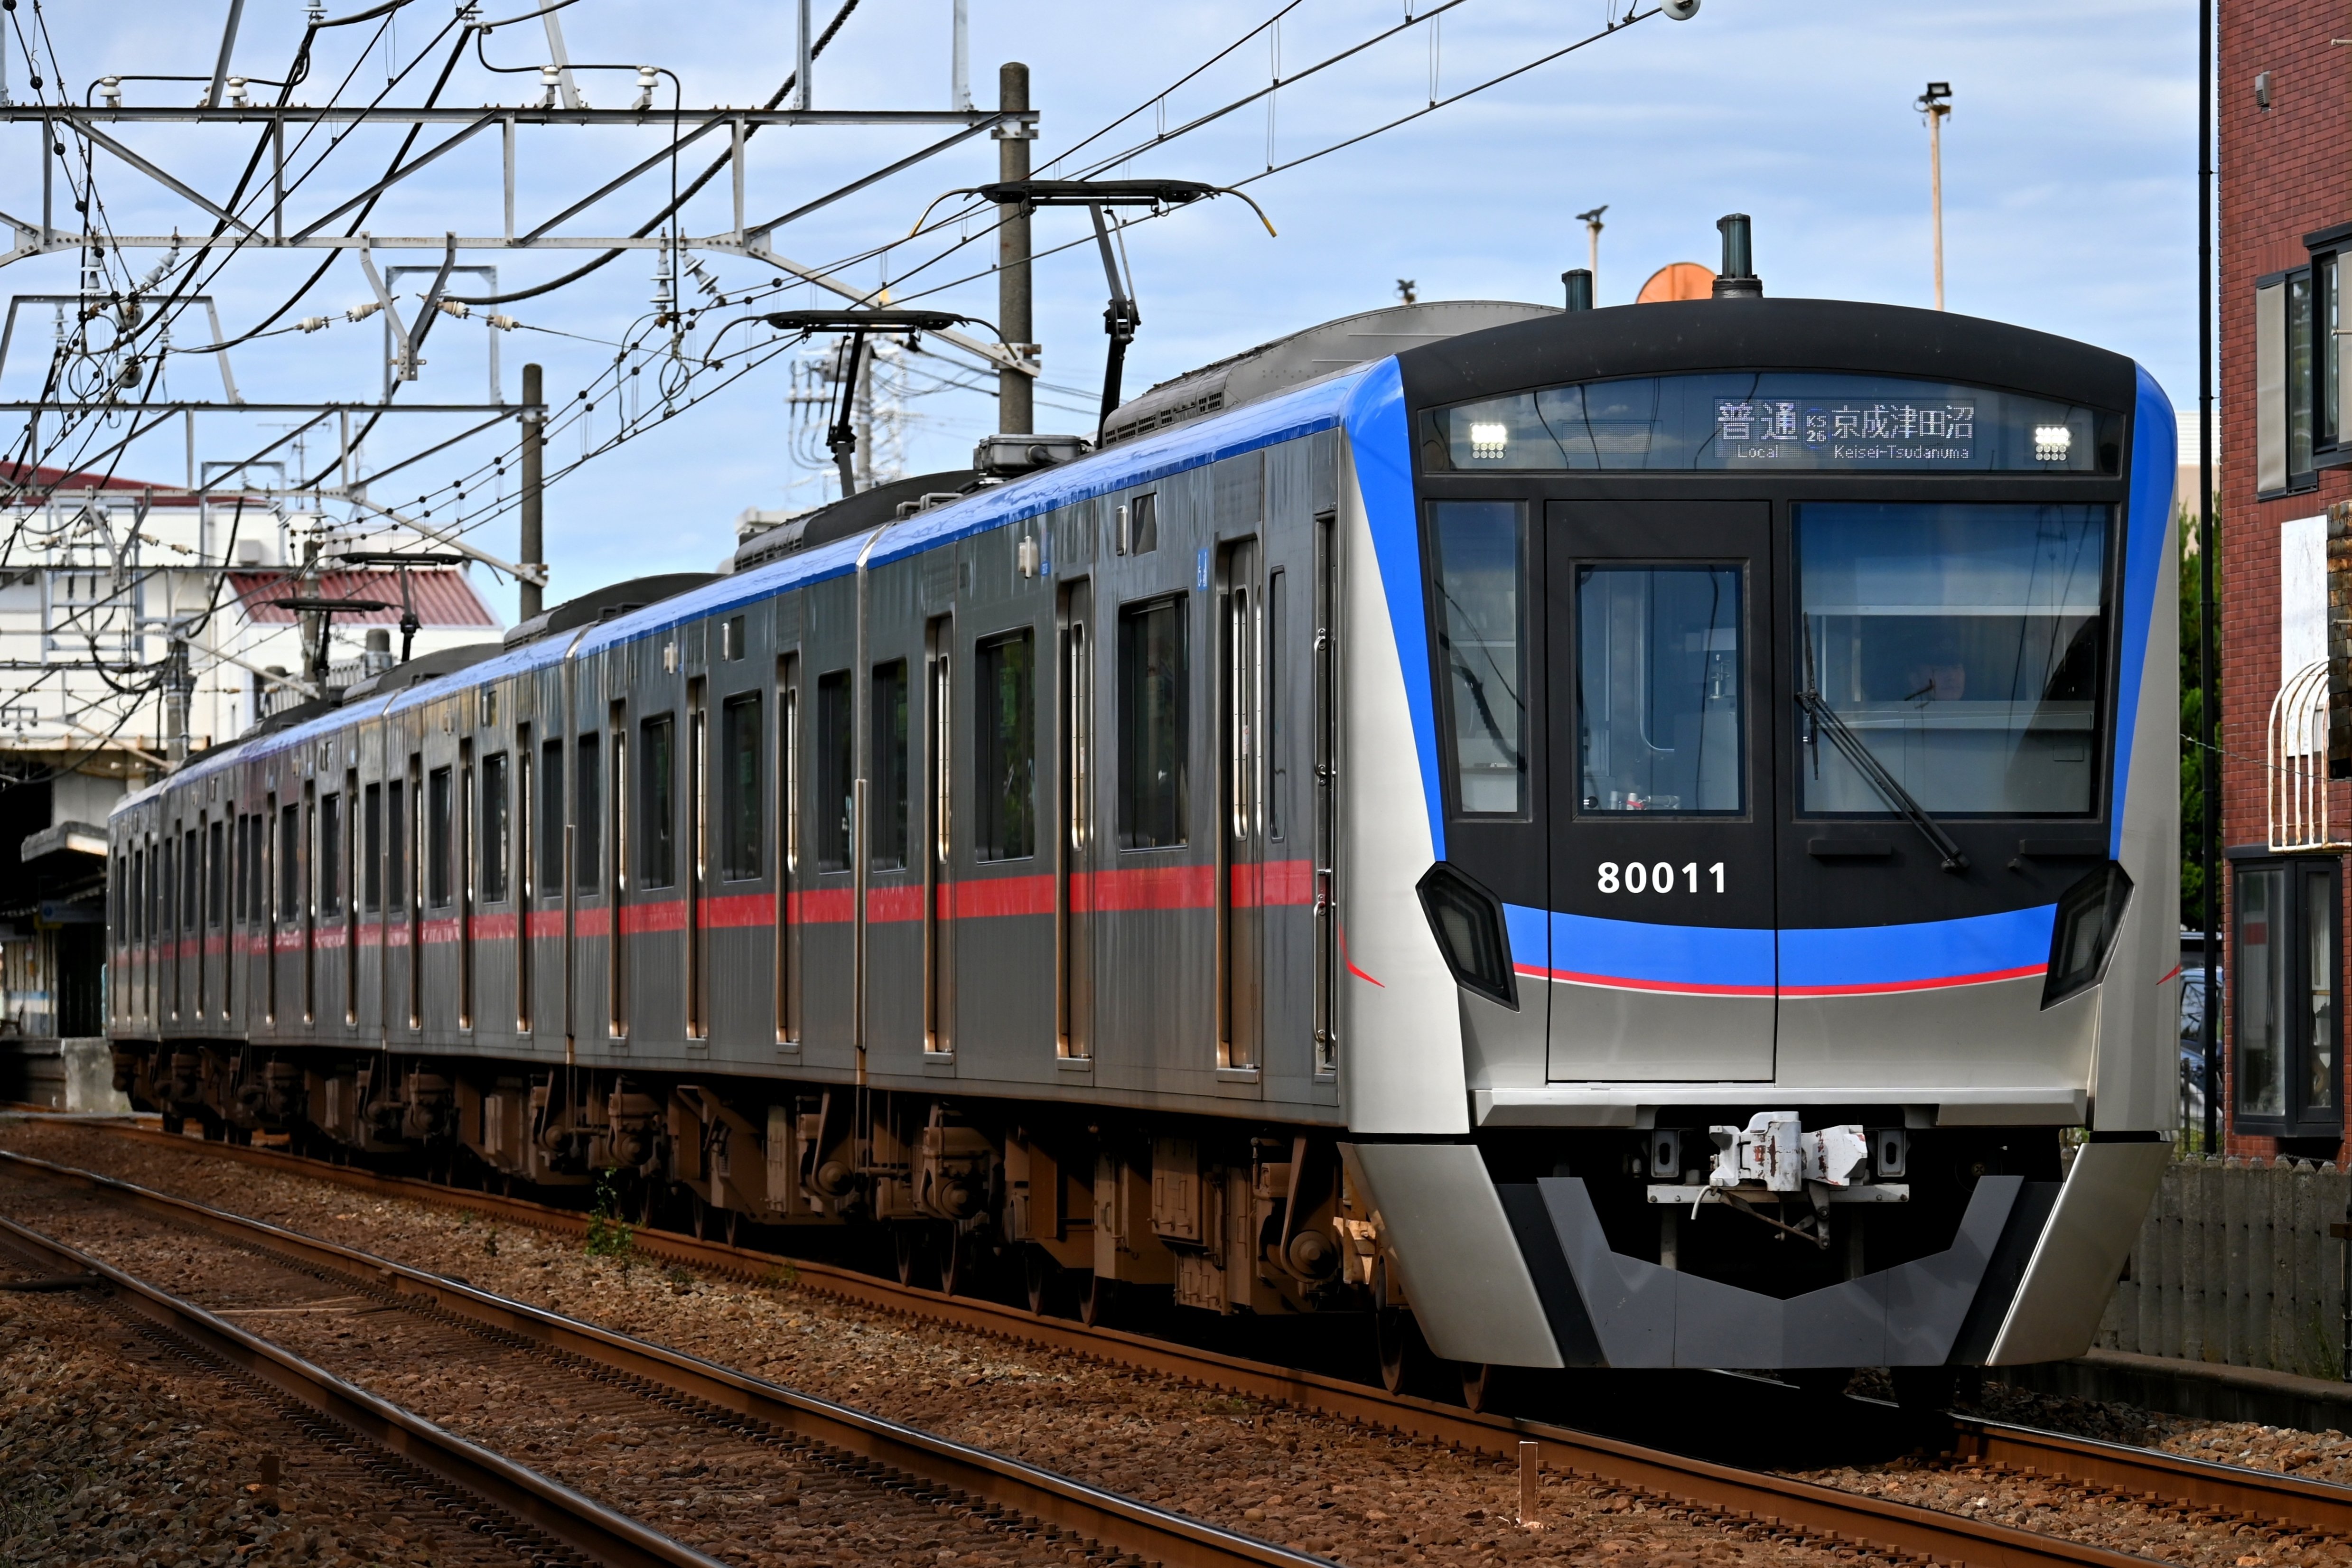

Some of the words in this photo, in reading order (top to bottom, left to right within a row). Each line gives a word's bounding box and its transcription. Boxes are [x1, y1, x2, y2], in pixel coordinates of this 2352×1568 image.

[1718, 402, 1798, 439] 普通
[1807, 416, 1826, 427] KS
[1832, 405, 1974, 439] 京成津田沼
[1807, 430, 1826, 441] 26
[1738, 445, 1778, 458] Local
[1835, 445, 1969, 458] Keisei-Tsudanuma
[1598, 862, 1724, 893] 80011
